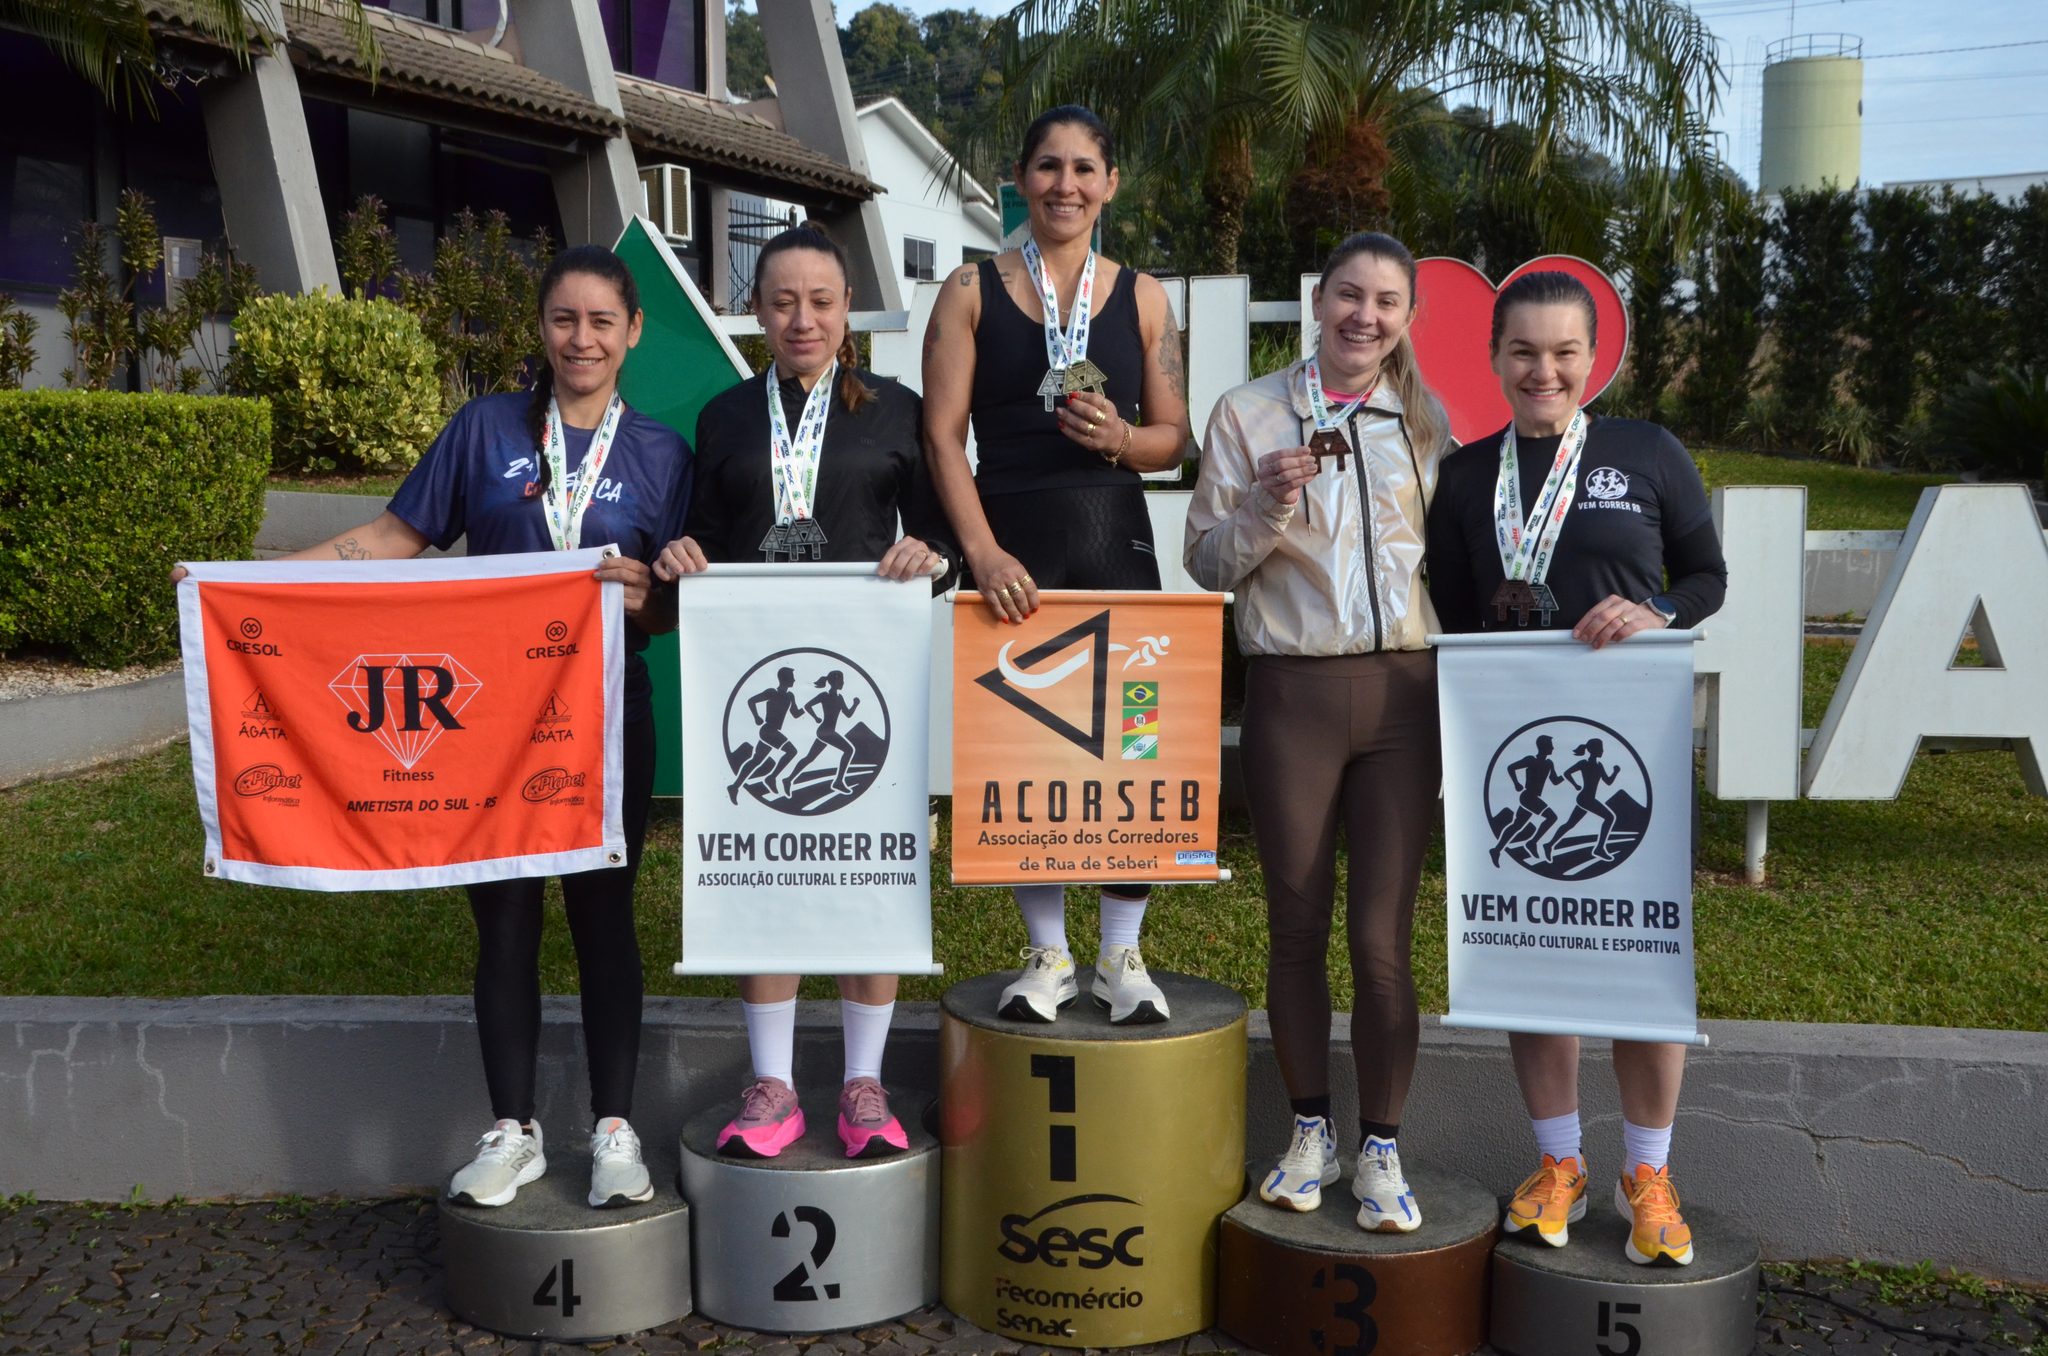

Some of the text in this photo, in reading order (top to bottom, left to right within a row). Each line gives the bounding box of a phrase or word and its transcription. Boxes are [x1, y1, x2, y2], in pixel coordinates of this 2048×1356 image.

[1578, 501, 1597, 510] VEM
[1599, 501, 1631, 511] CORRER
[226, 639, 283, 657] CRESOL
[526, 642, 580, 660] CRESOL
[347, 665, 467, 733] JR
[238, 721, 288, 741] ÁGATA
[529, 728, 575, 744] ÁGATA
[252, 770, 303, 789] Planet
[383, 769, 435, 782] Fitness
[539, 771, 586, 791] Planet
[346, 800, 413, 813] AMETISTA
[418, 799, 439, 812] DO
[444, 798, 470, 810] SUL
[484, 796, 498, 809] RS
[981, 780, 1200, 823] ACORSEB
[697, 832, 917, 862] VEM CORRER RB
[978, 828, 1199, 849] Associação dos Corredores
[1019, 855, 1158, 871] de Rua de Seberi
[698, 871, 917, 888] ASSOCIAÇÃO CULTURAL E ESPORTIVA
[1461, 894, 1680, 930] VEM CORRER RB
[1462, 931, 1680, 955] ASSOCIAÇÃO CULTURAL E ESPORTIVA
[1031, 1054, 1077, 1183] 1
[997, 1194, 1144, 1269] Sesc
[771, 1206, 840, 1302] 2
[533, 1259, 581, 1317] 4
[996, 1277, 1143, 1310] Fecomércio
[1311, 1263, 1378, 1356] 3
[996, 1308, 1072, 1338] Senac
[1596, 1301, 1641, 1356] 5
